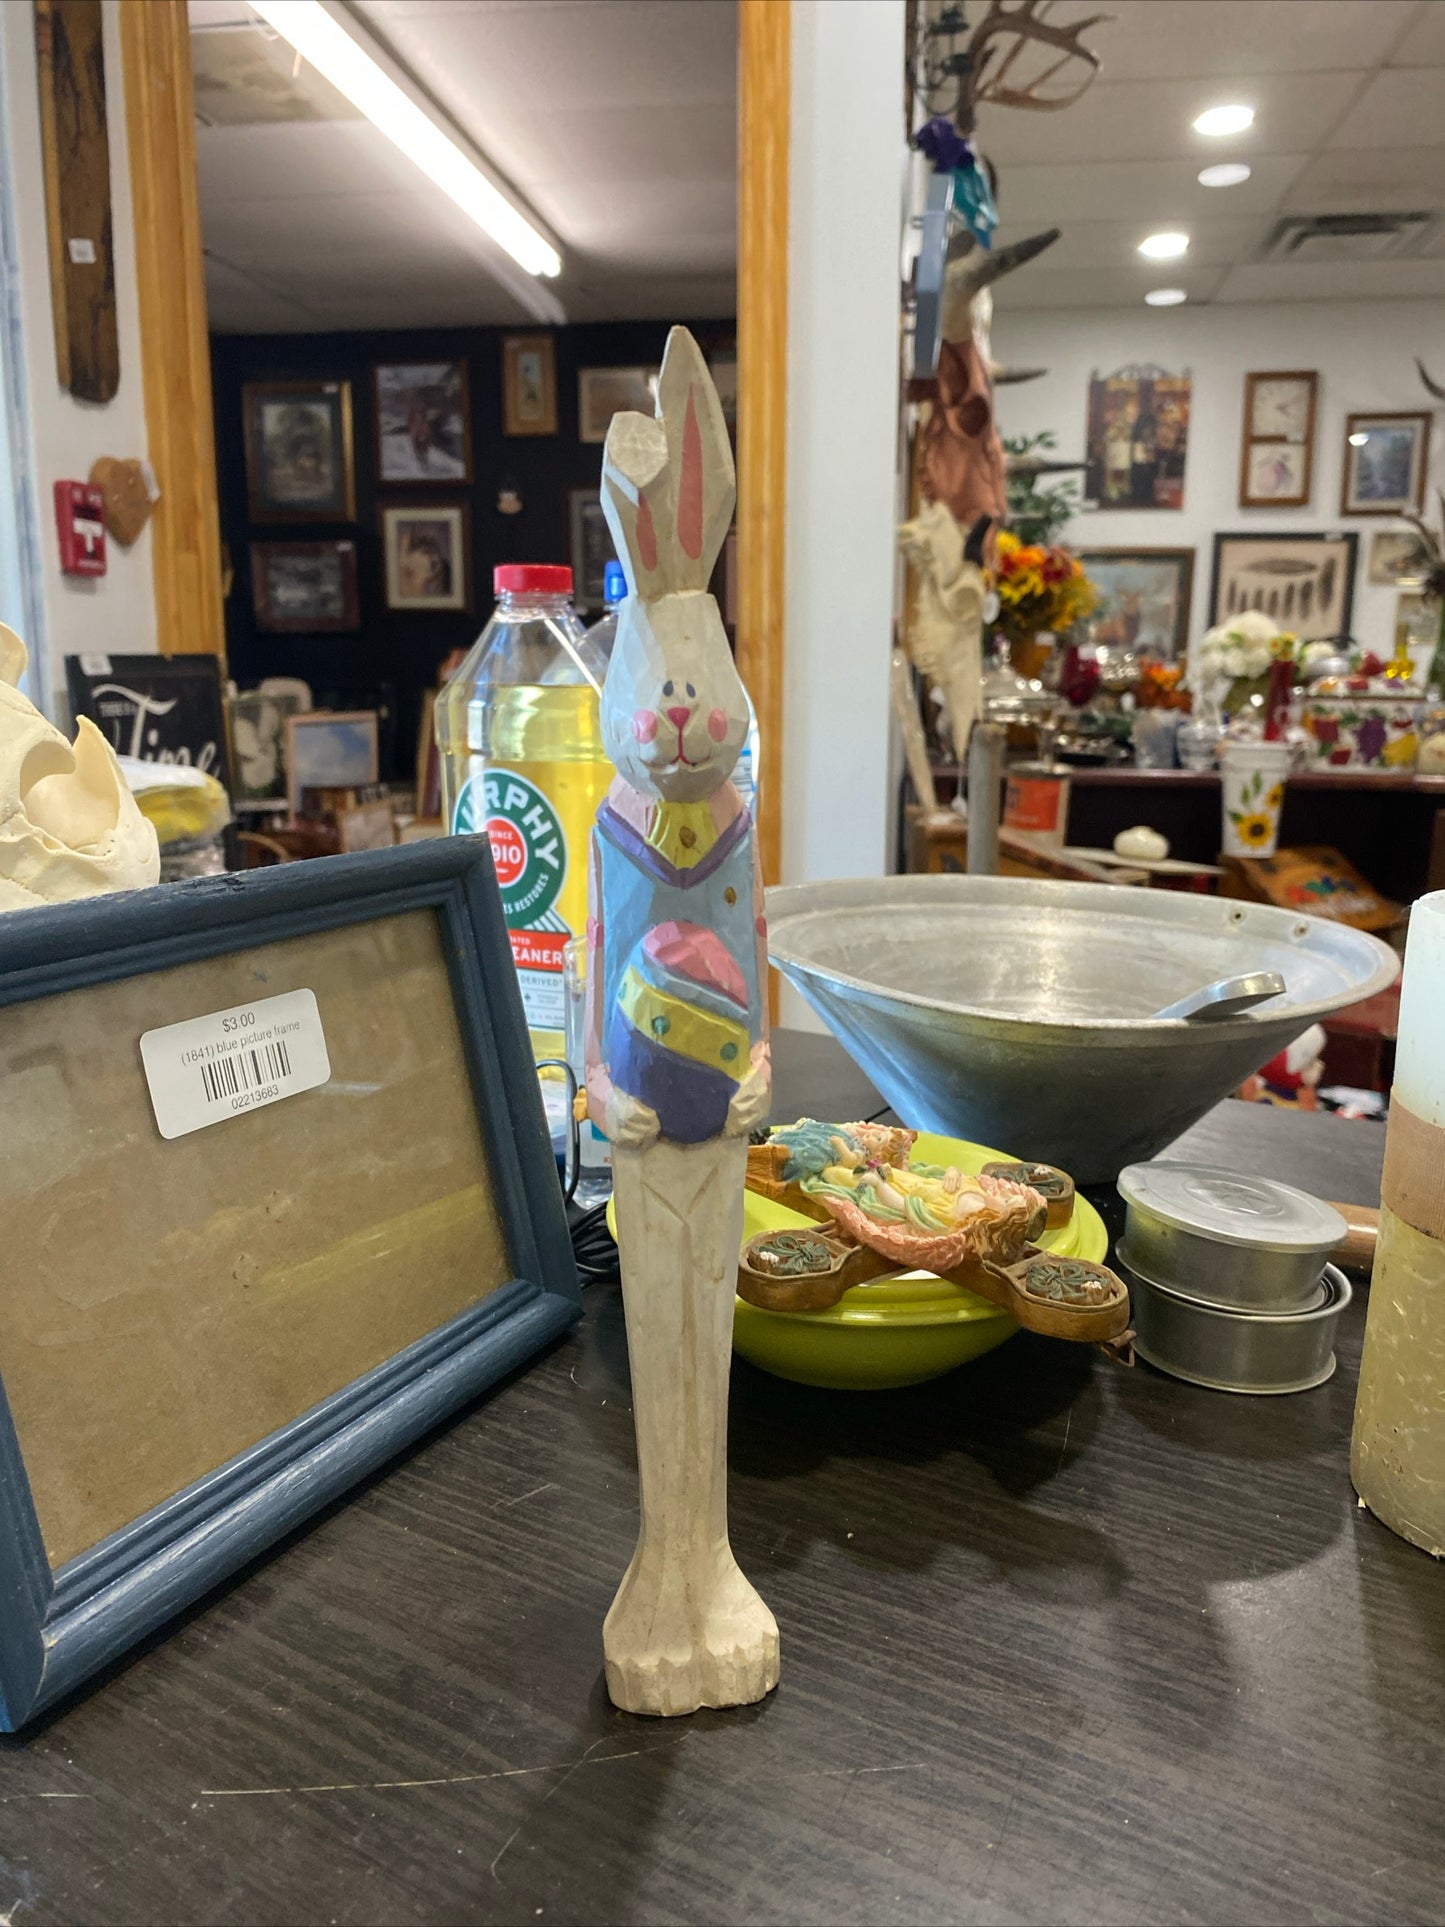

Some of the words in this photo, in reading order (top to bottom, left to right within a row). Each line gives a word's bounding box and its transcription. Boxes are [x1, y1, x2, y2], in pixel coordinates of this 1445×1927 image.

[458, 780, 559, 870] URPHY
[491, 843, 522, 865] 910
[514, 873, 550, 913] RESTORES
[511, 946, 562, 966] EANER
[222, 1012, 256, 1033] $3.00
[181, 1046, 215, 1066] (1841)
[216, 1038, 238, 1055] blue
[240, 1030, 272, 1049] picture
[273, 1019, 301, 1037] frame
[231, 1084, 280, 1110] 02213683
